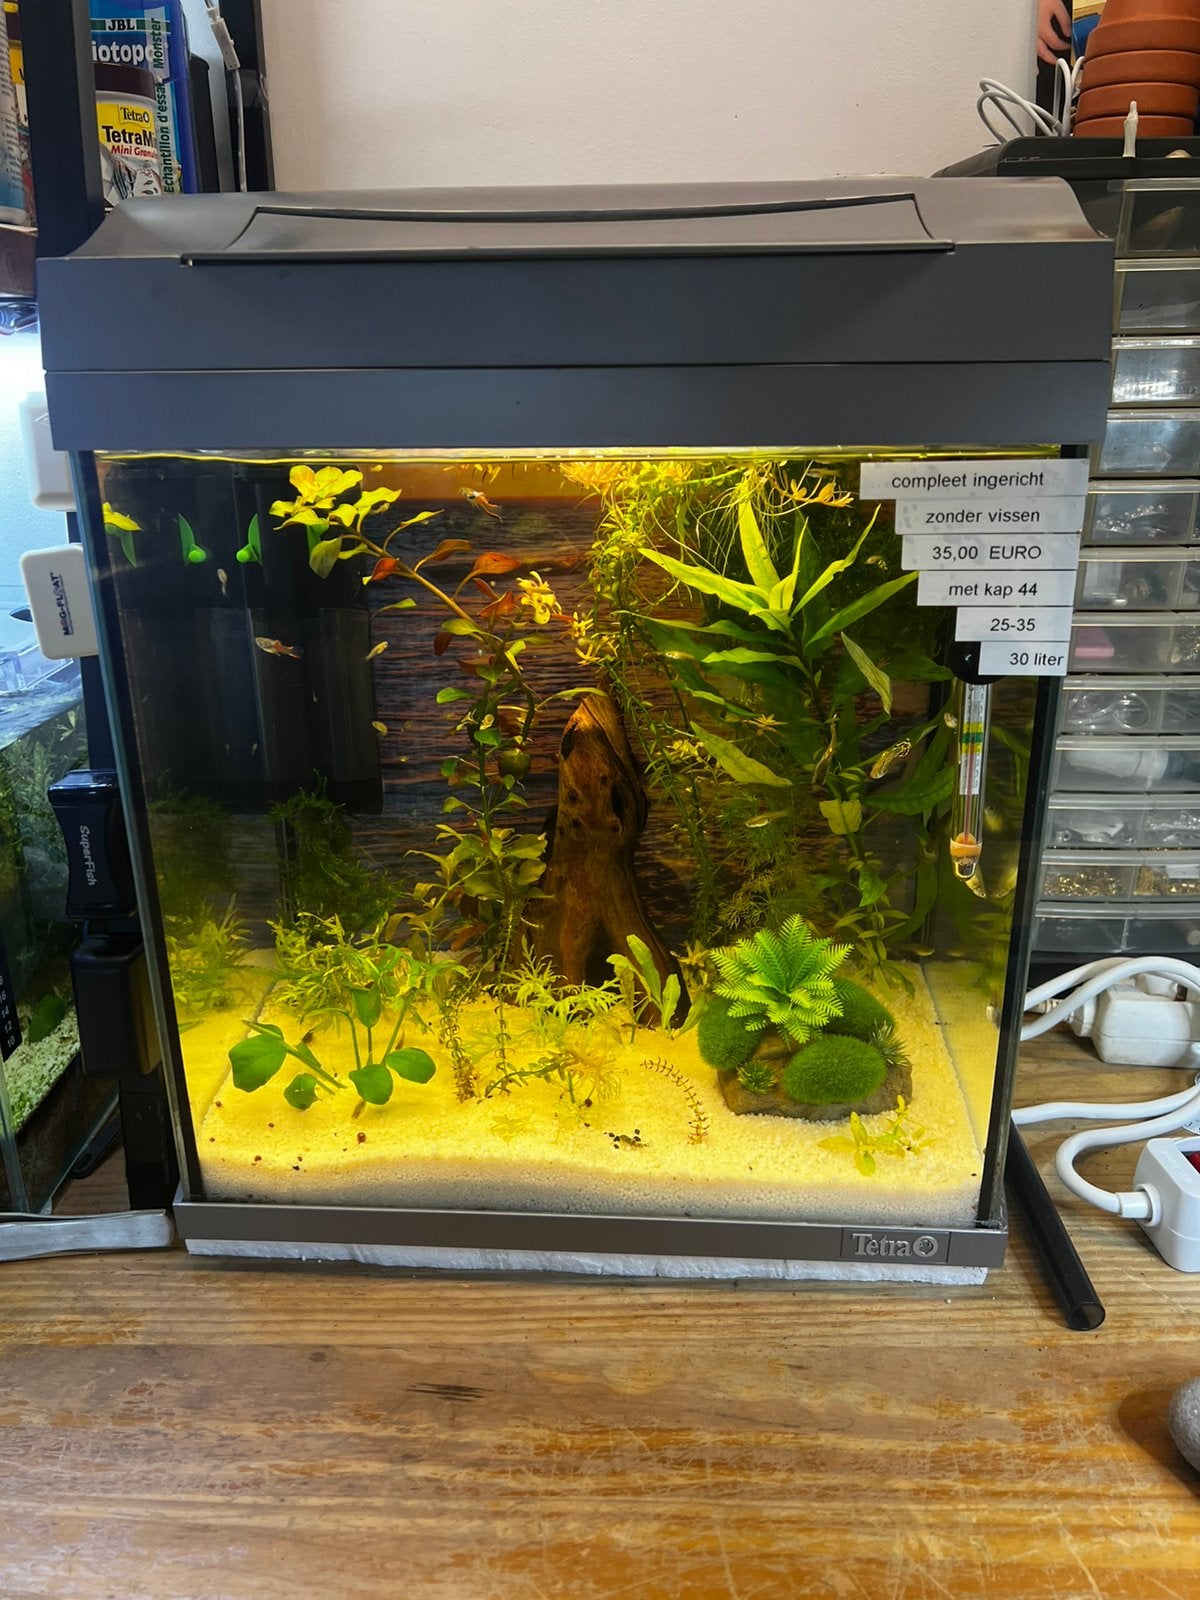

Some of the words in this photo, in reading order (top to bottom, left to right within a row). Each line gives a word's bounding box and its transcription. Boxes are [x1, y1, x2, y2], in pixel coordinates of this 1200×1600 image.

[108, 19, 135, 31] JBL
[150, 18, 164, 69] Monster
[111, 145, 132, 155] Mini
[159, 125, 174, 193] Echantillon
[892, 474, 967, 491] compleet
[973, 472, 1044, 489] ingericht
[926, 509, 982, 524] zonder
[988, 509, 1040, 523] vissen
[932, 546, 978, 561] 35,00
[989, 545, 1042, 560] EURO
[949, 583, 979, 596] met
[984, 582, 1013, 598] kap
[1018, 583, 1038, 596] 44
[990, 618, 1036, 632] 25-35
[1010, 653, 1029, 666] 30
[1034, 652, 1064, 666] liter
[80, 825, 98, 886] SuperFish
[4, 1020, 13, 1034] 12
[7, 1035, 15, 1048] 10
